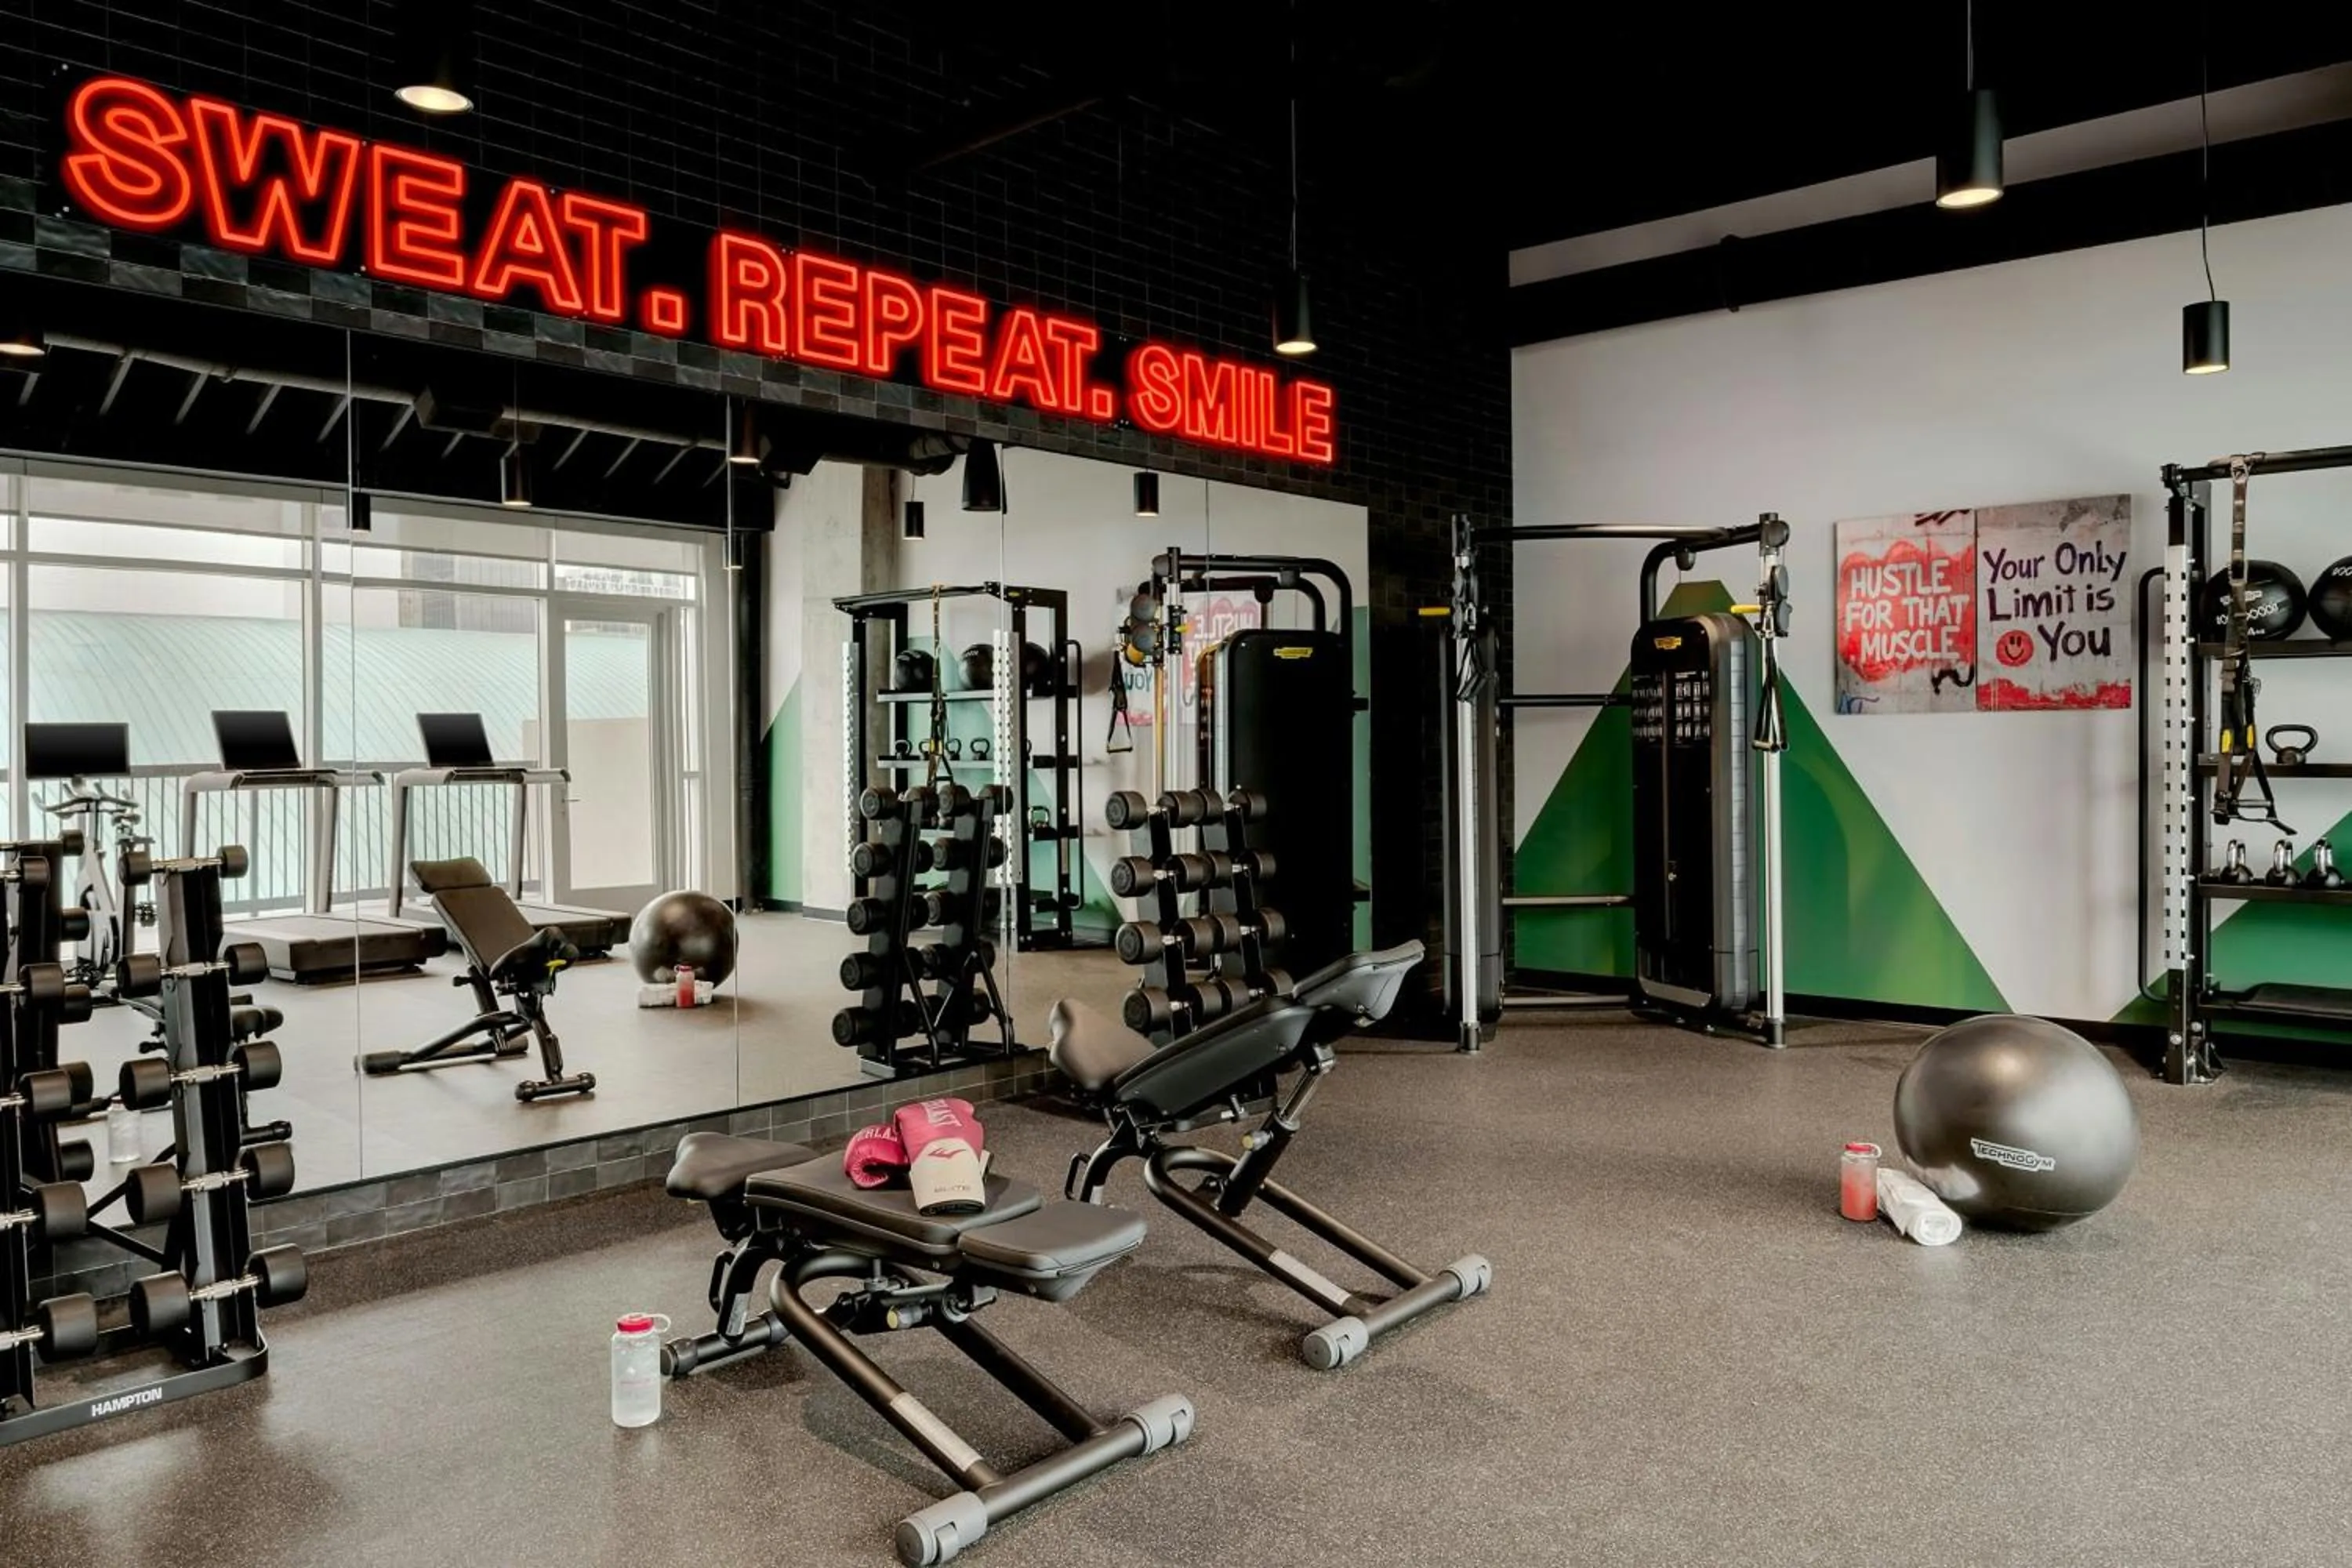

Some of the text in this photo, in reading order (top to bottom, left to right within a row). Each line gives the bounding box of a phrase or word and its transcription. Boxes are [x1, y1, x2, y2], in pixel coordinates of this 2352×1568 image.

[66, 77, 1334, 464] SWEAT. REPEAT. SMILE
[1851, 558, 1951, 600] HUSTLE
[1983, 539, 2127, 584] Your Only
[1845, 593, 1970, 633] FOR THAT
[1987, 583, 2114, 622] Limit is
[1860, 626, 1960, 665] MUSCLE
[2038, 620, 2111, 662] You
[92, 1386, 162, 1417] HAMPTON
